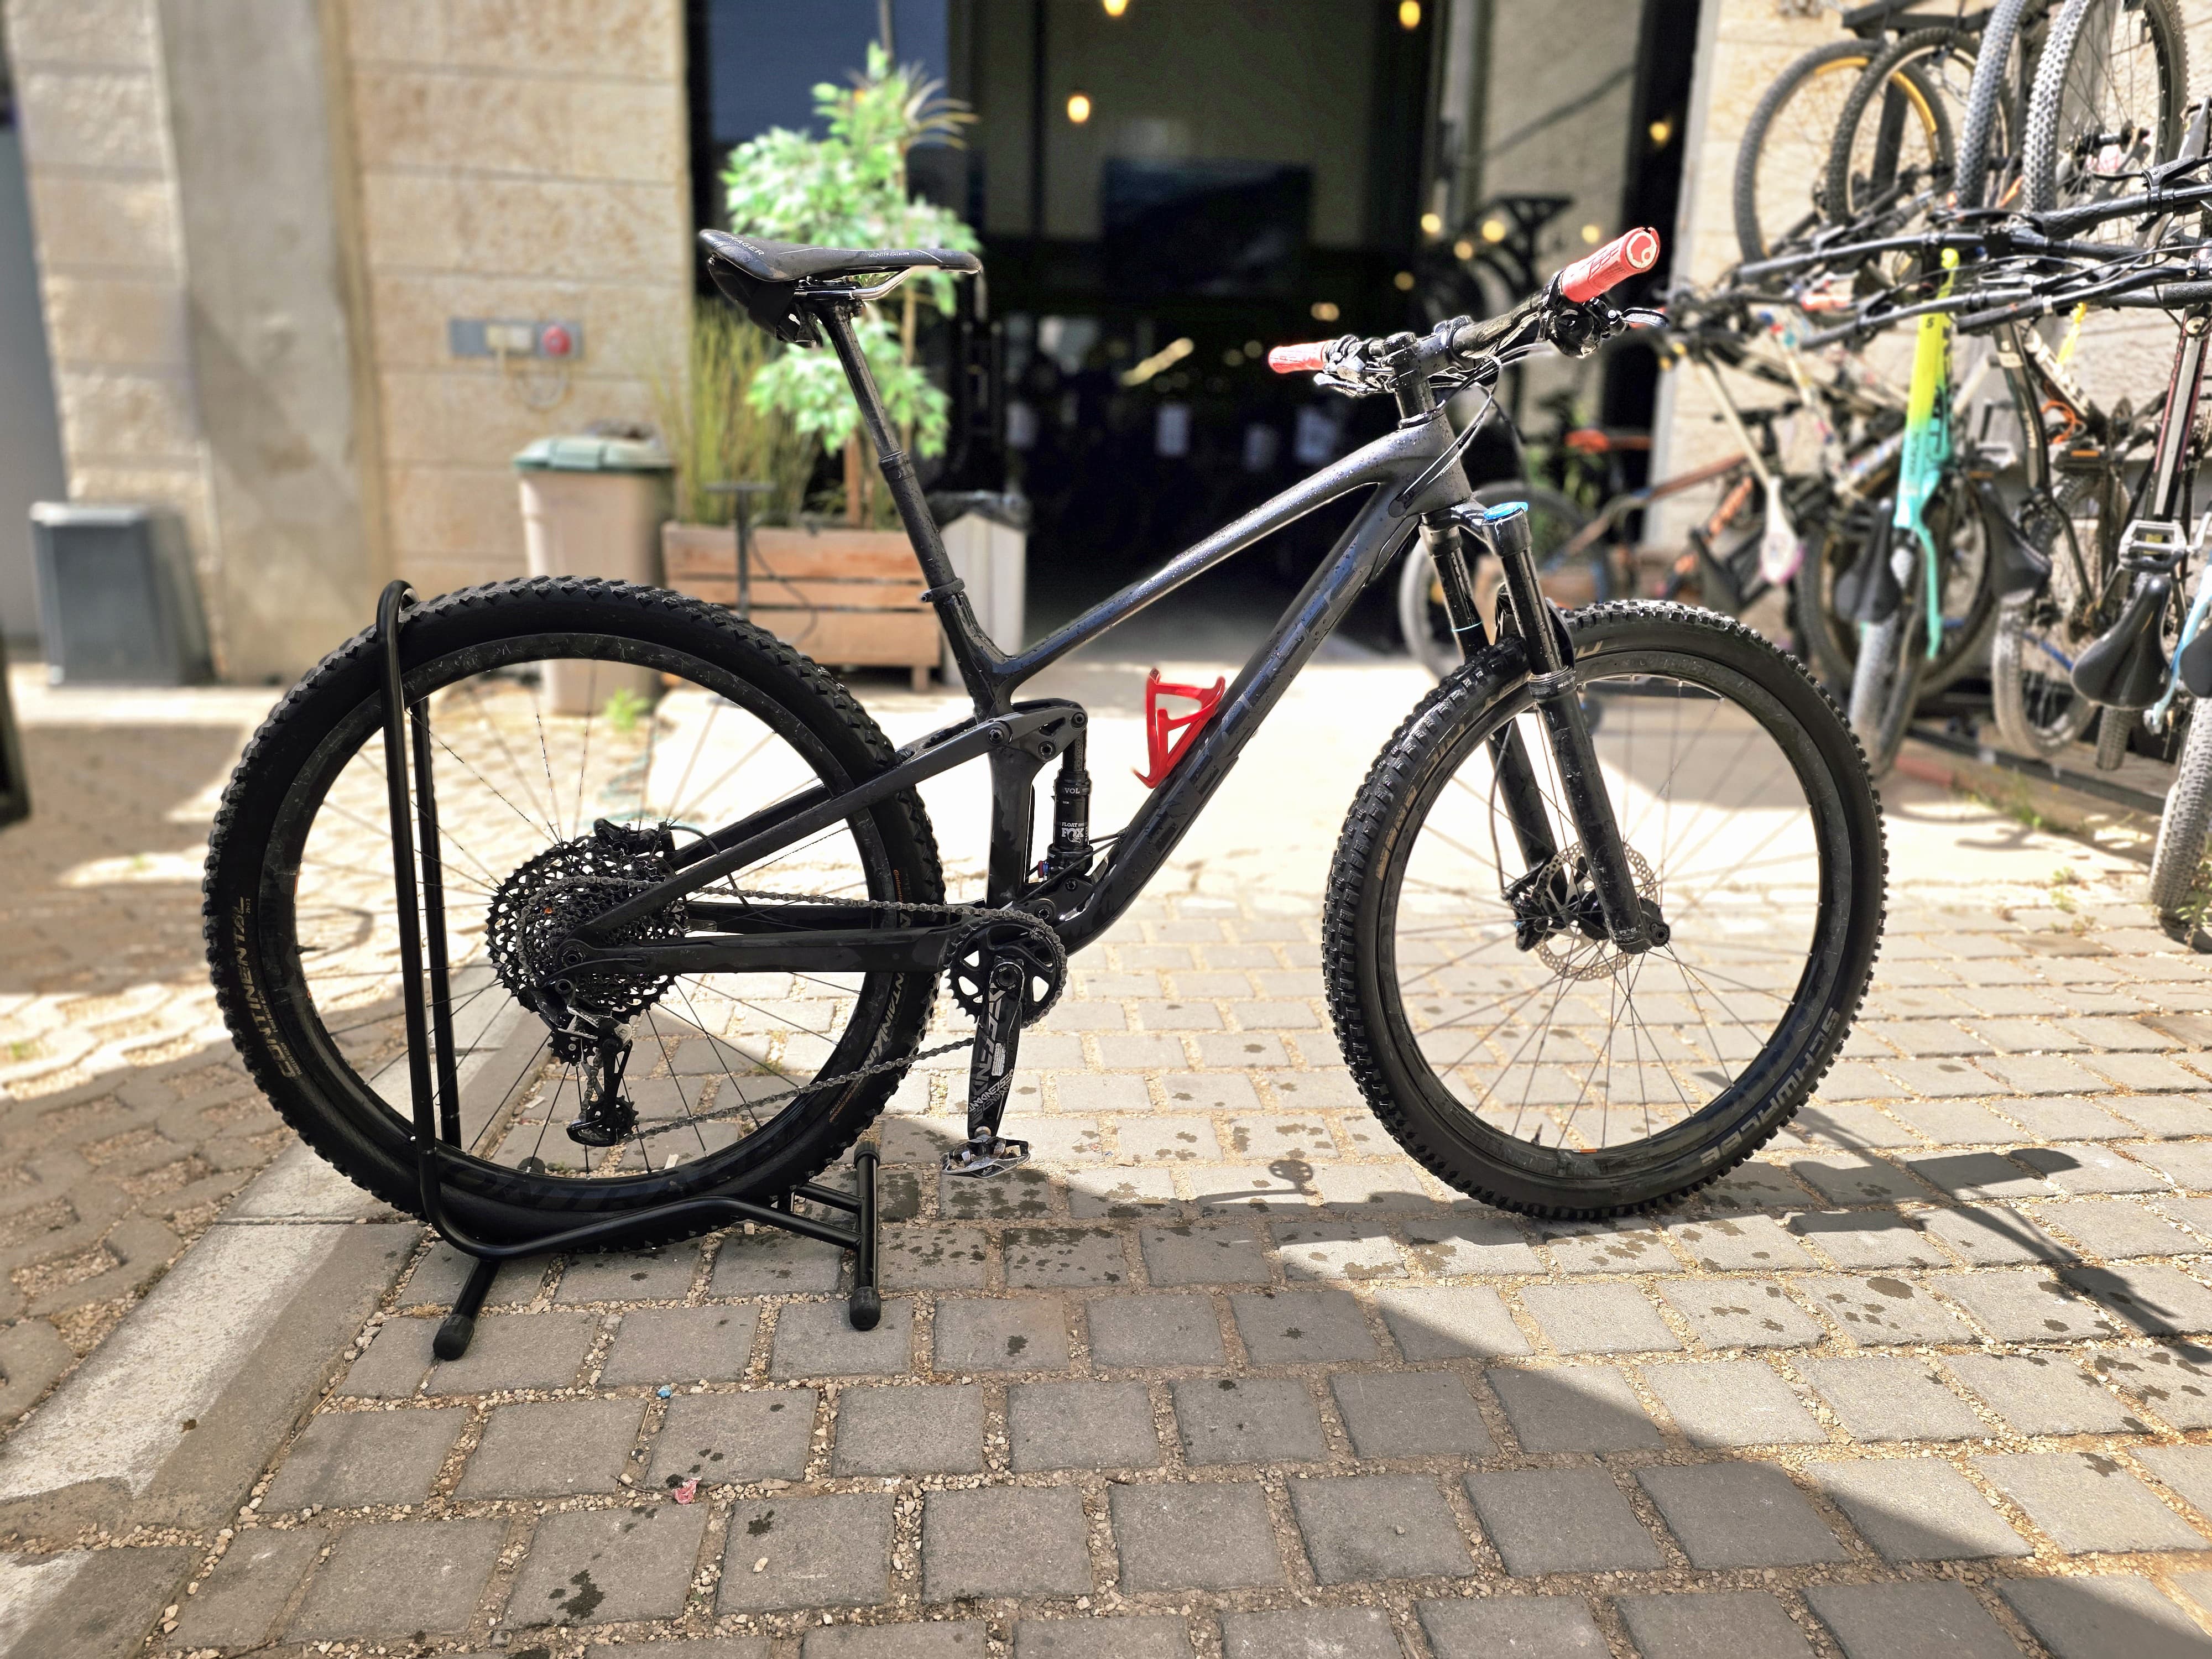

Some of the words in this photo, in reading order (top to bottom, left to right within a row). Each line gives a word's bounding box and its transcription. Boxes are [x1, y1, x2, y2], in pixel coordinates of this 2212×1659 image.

[721, 232, 765, 257] TRAGER
[1061, 827, 1084, 843] FOX
[232, 896, 297, 1079] CONTINENTAL
[1700, 1007, 1841, 1166] SCHWALBE
